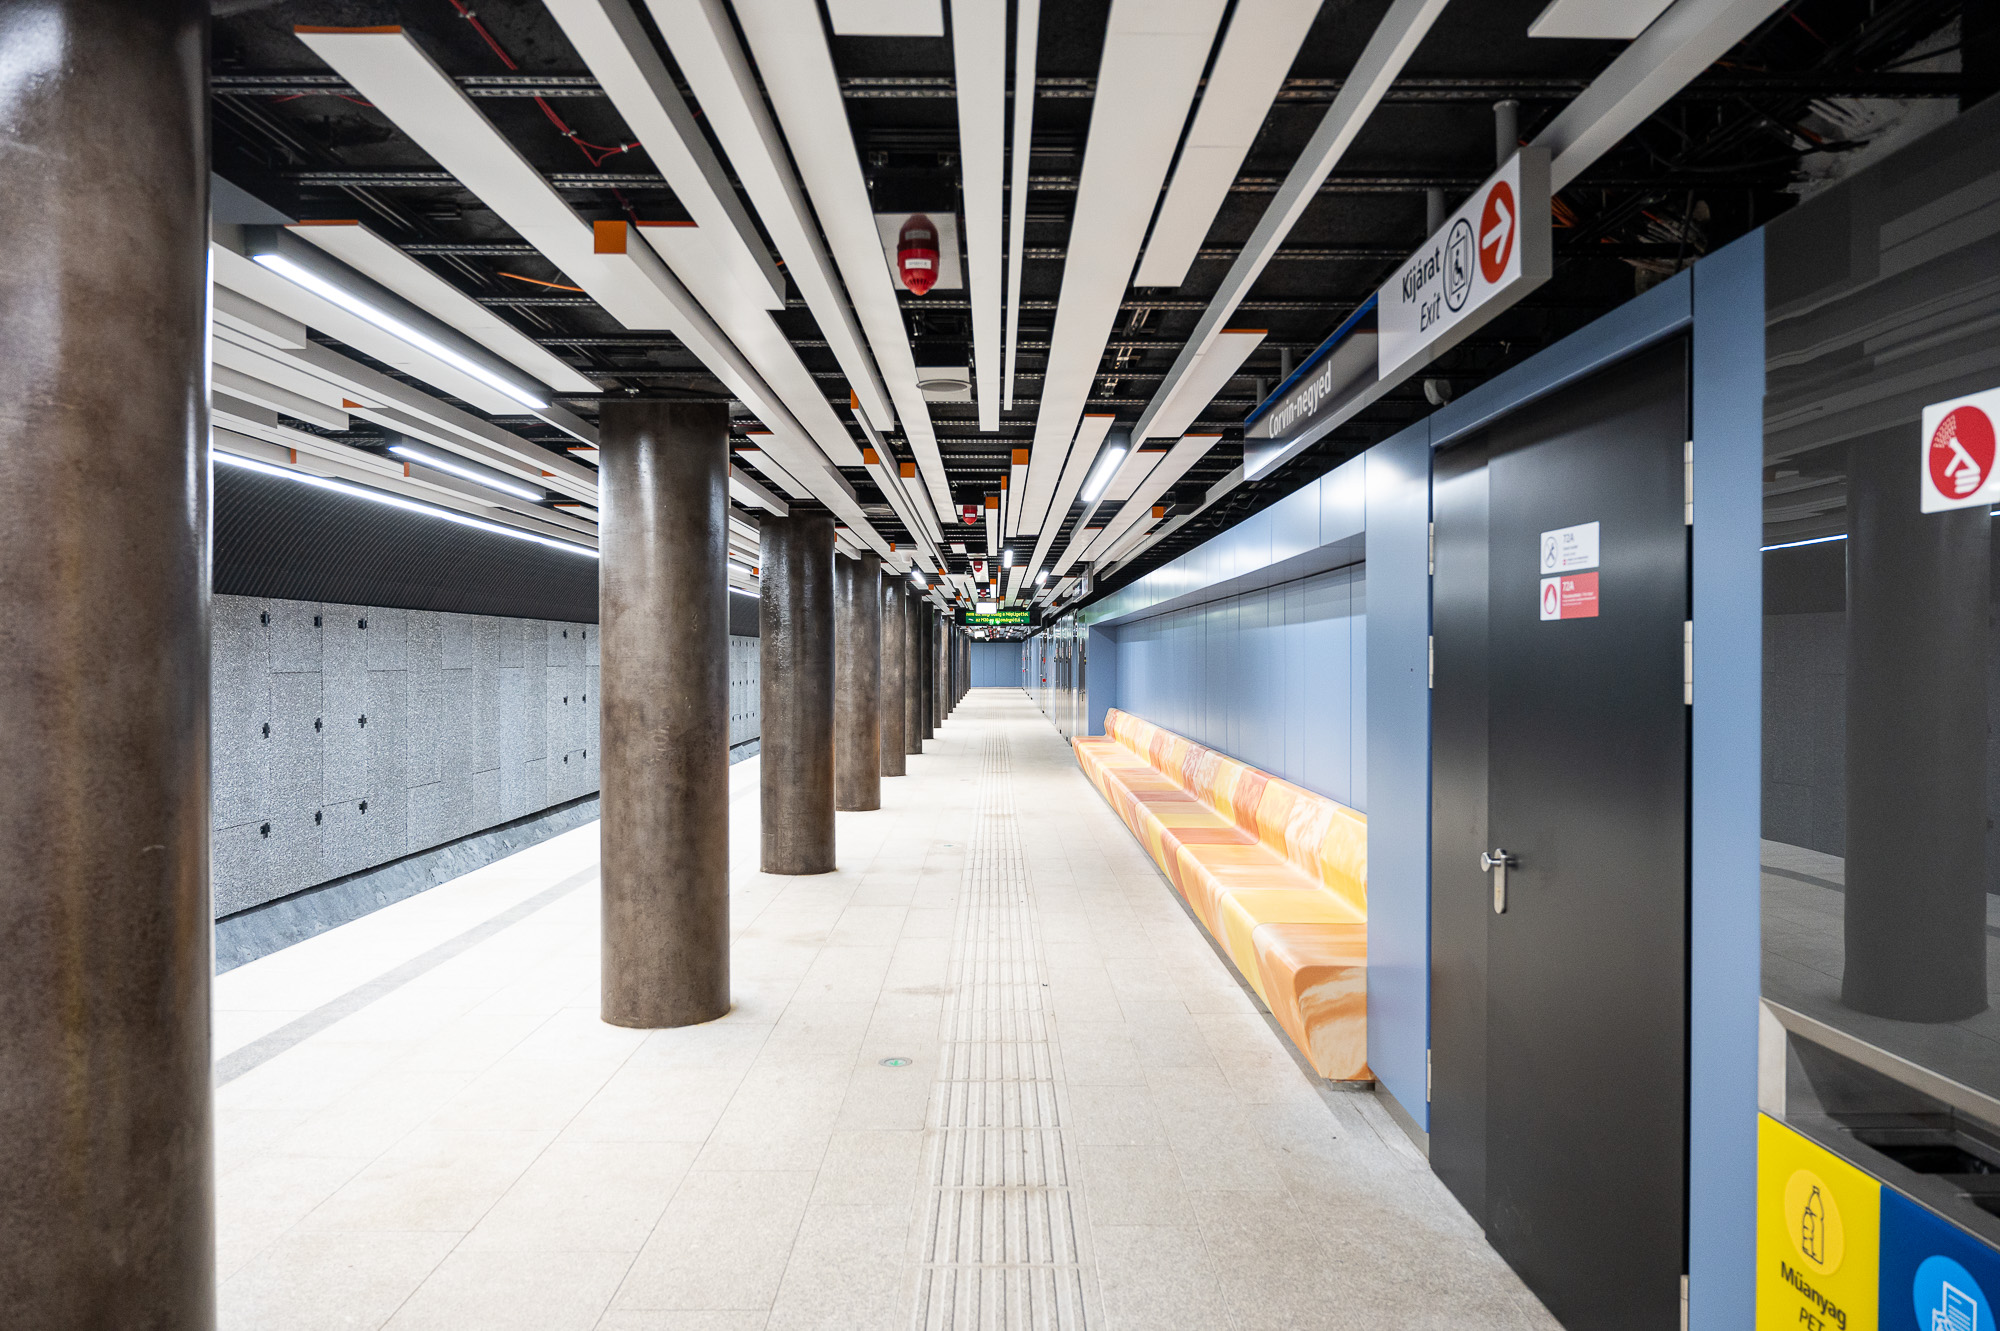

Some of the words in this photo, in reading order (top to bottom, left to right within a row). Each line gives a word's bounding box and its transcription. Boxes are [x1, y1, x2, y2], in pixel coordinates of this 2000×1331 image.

[1402, 246, 1441, 303] Kijárat
[1420, 292, 1441, 333] Exit
[1268, 360, 1332, 439] Corvin-negyed
[1799, 1307, 1826, 1331] PET
